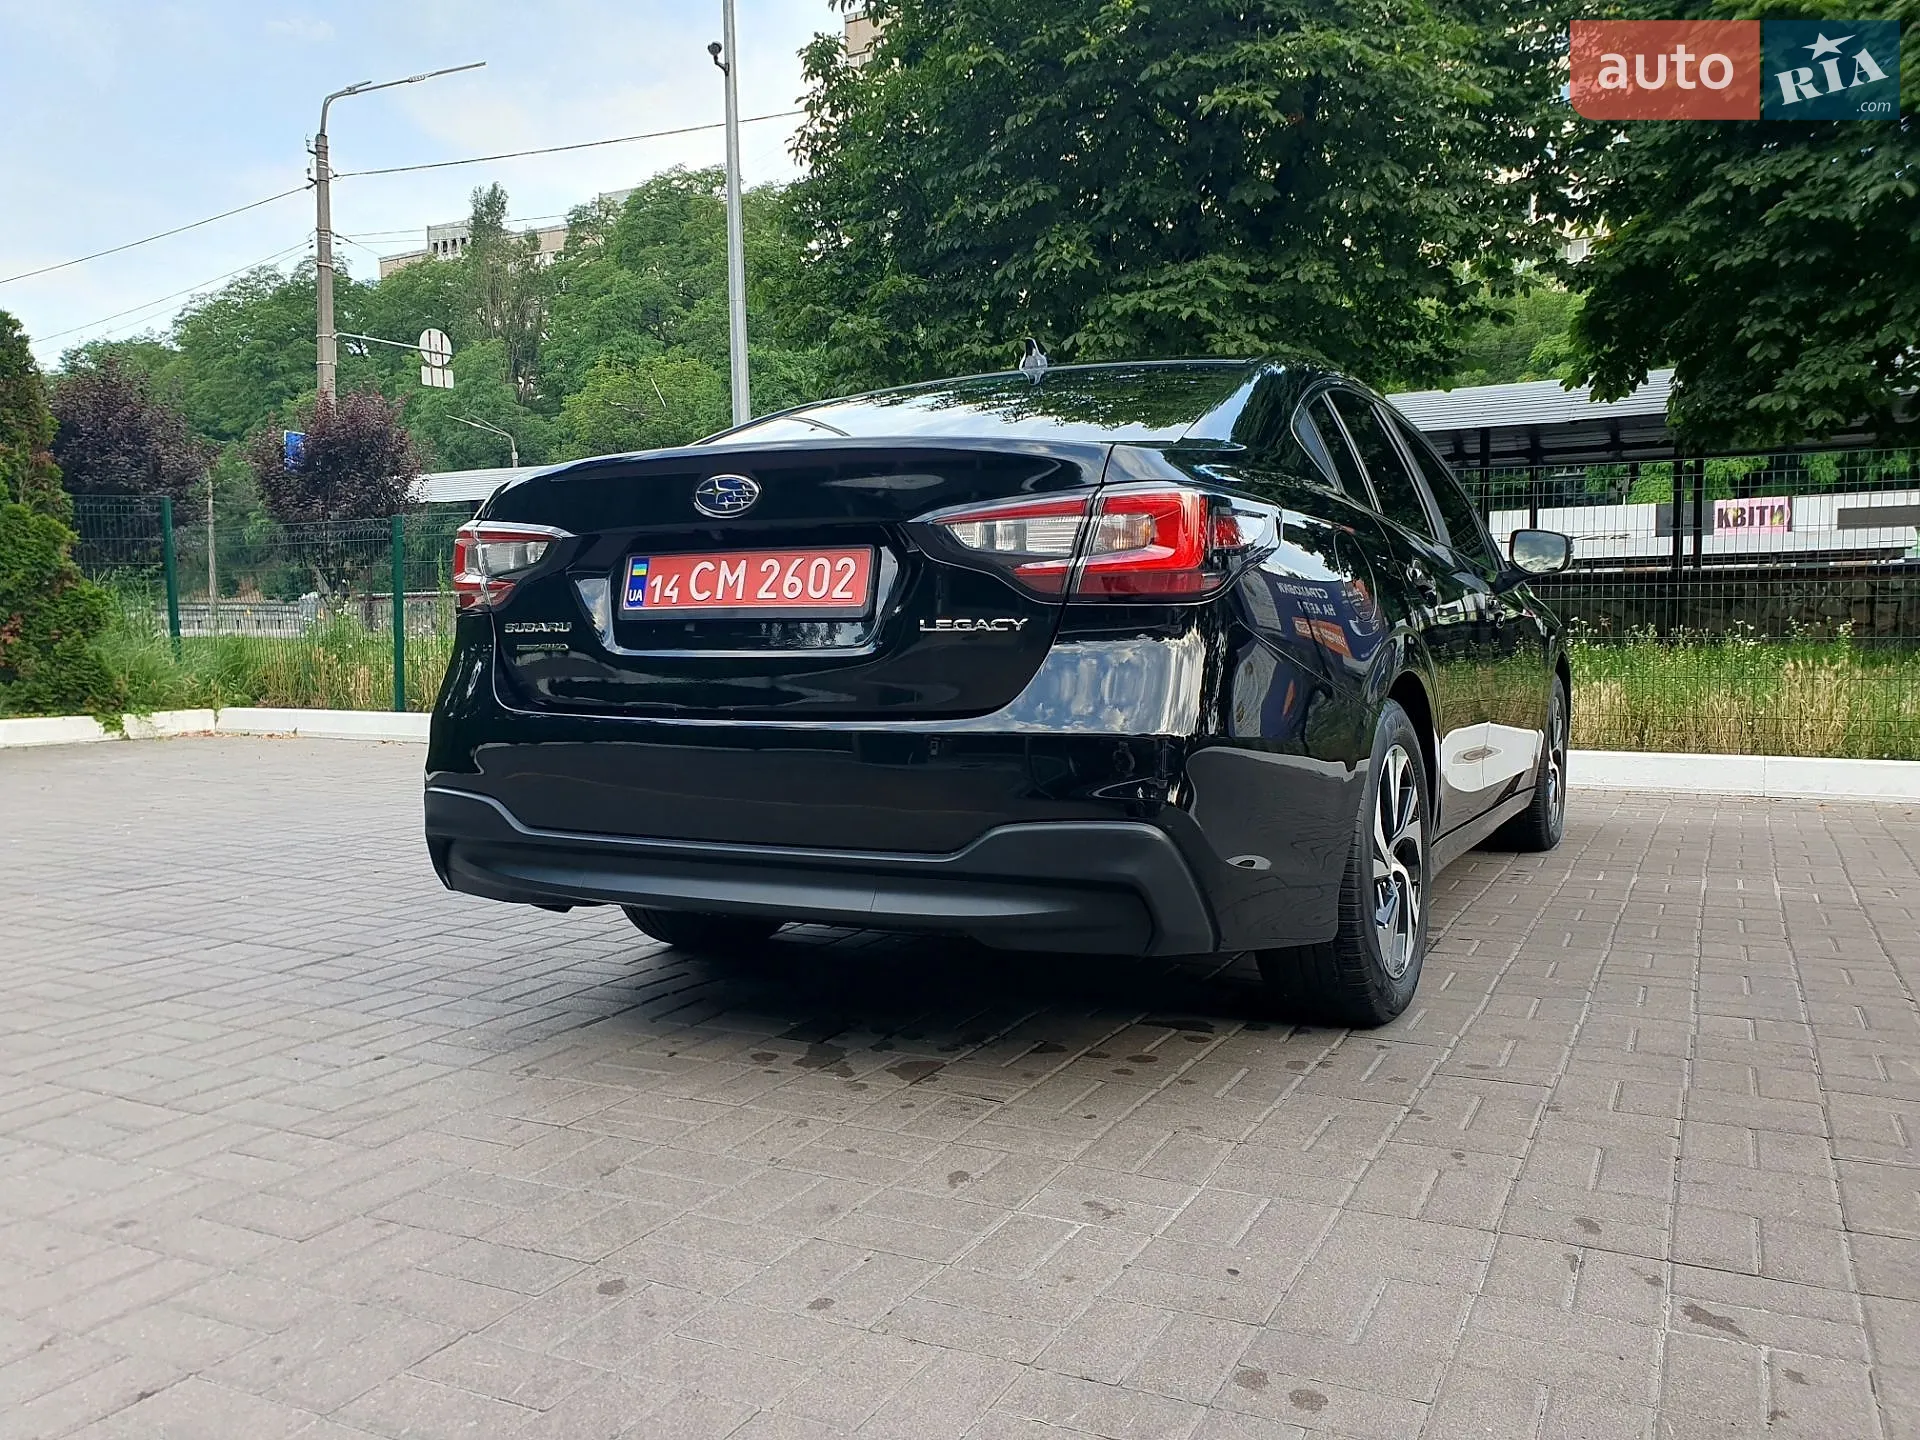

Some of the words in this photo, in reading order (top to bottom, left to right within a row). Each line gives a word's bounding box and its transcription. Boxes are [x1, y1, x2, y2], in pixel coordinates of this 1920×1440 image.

[1717, 505, 1785, 528] КВІТИ
[650, 574, 680, 604] 14
[689, 560, 747, 601] CM
[756, 557, 857, 600] 2602
[628, 589, 643, 602] UA
[504, 621, 573, 633] SUBARU
[919, 618, 1029, 632] LEGACY
